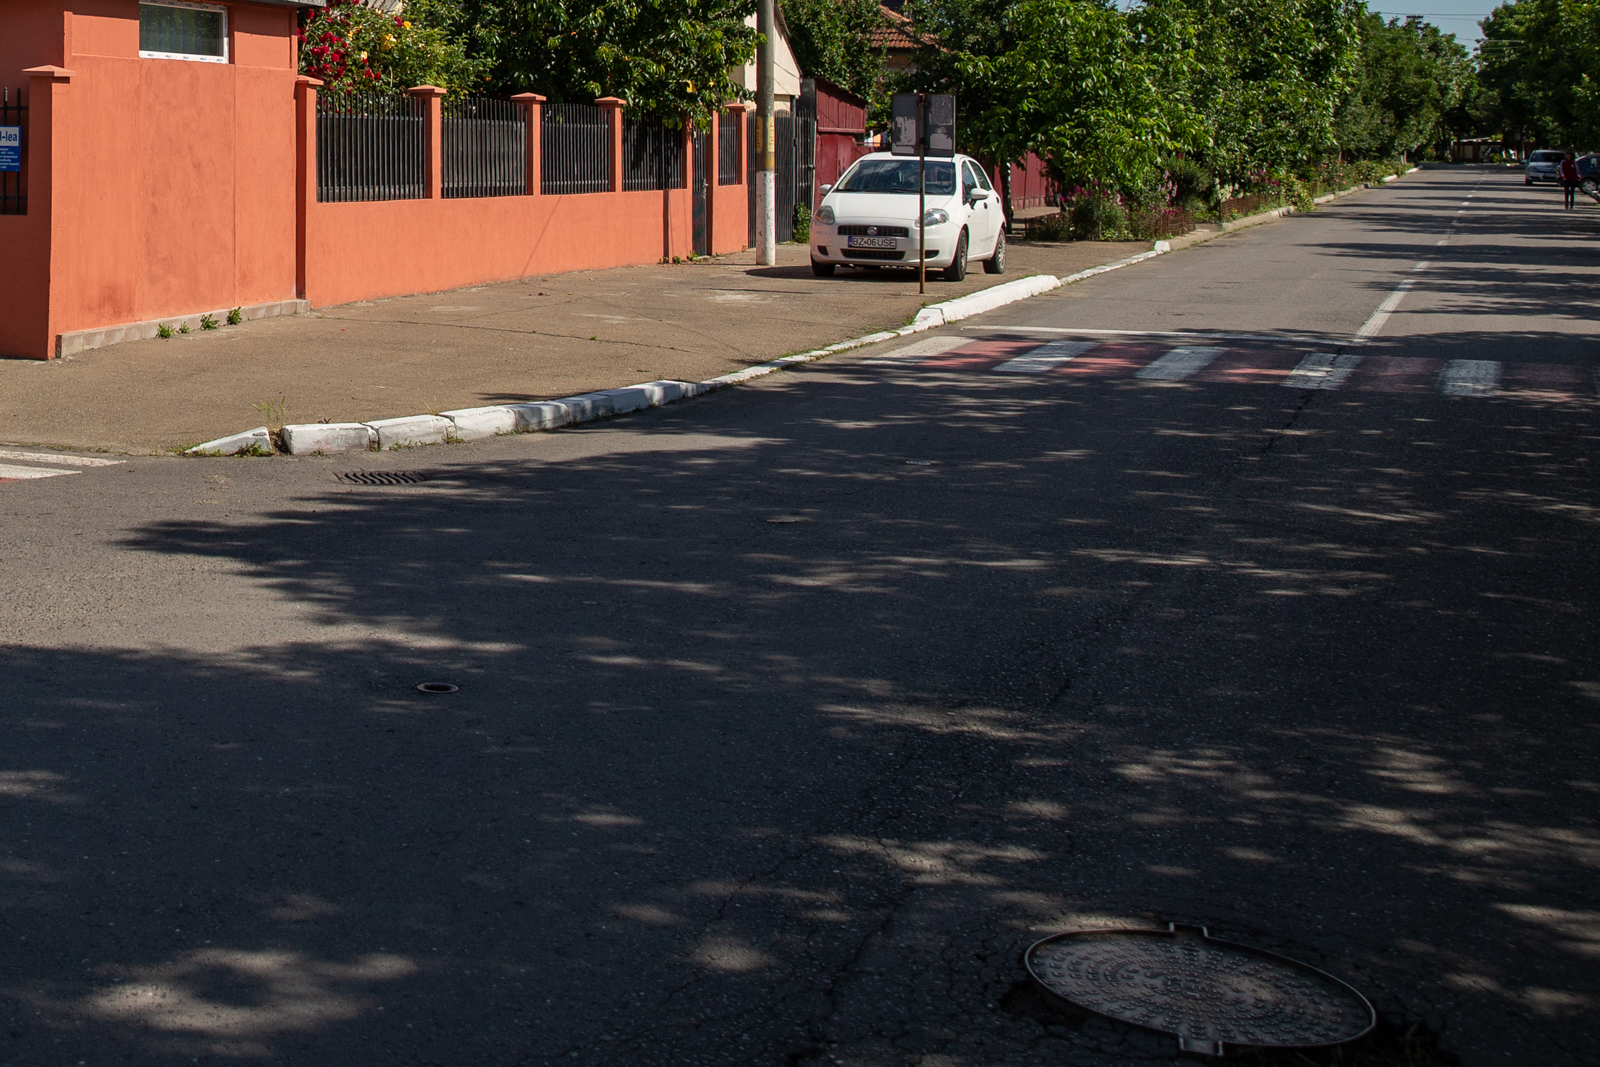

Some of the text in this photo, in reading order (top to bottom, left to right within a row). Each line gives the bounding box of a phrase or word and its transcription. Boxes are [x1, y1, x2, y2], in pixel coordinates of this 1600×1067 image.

[852, 237, 896, 248] BZ 06 USE
